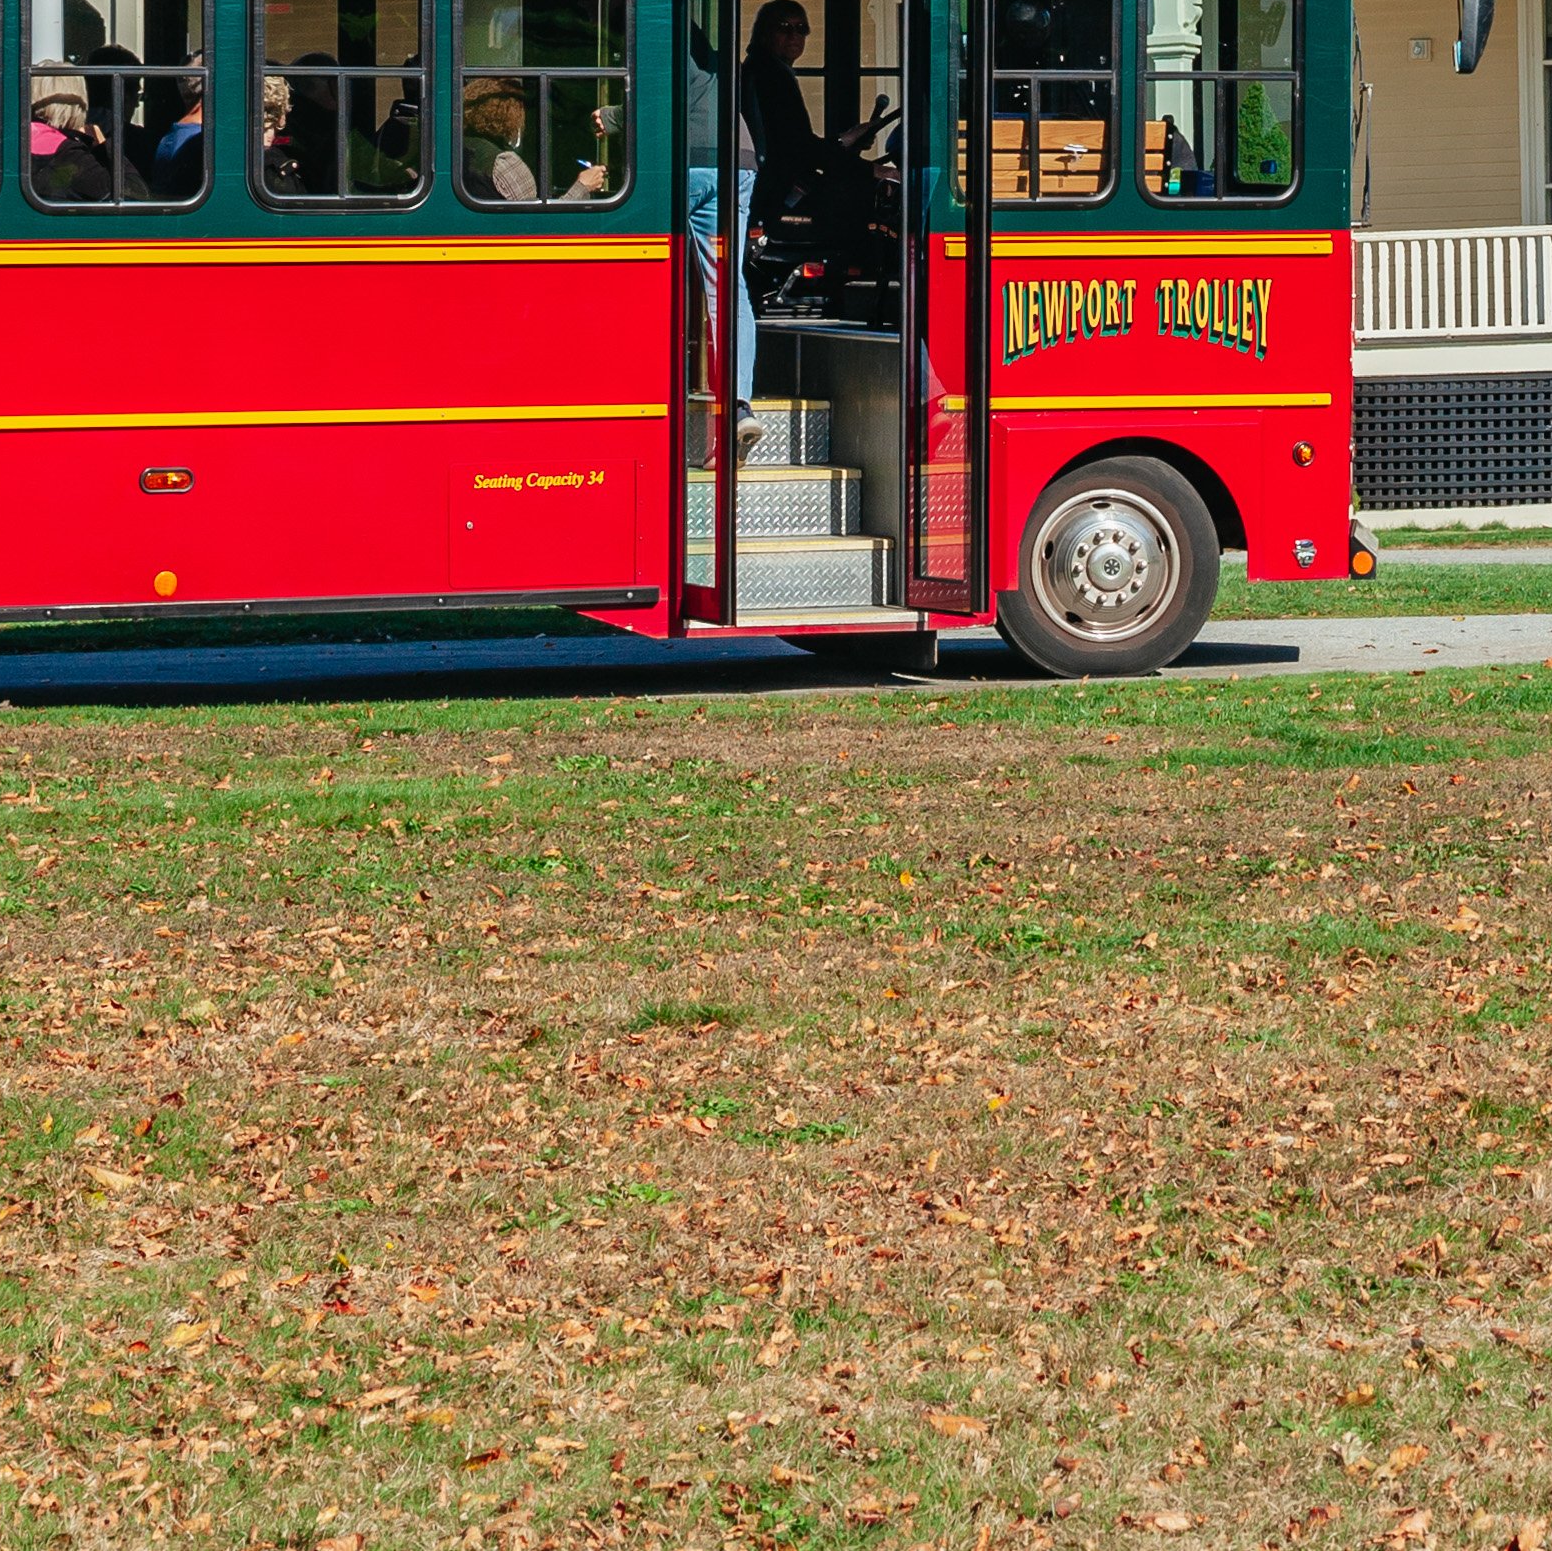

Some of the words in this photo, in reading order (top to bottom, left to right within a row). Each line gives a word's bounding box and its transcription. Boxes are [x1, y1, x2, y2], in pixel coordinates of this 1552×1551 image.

[1002, 279, 1137, 366] NEWPORT
[1155, 278, 1272, 361] TROLLEY
[474, 474, 523, 491] Seating
[526, 472, 585, 490] Capacity
[587, 470, 605, 485] 34
